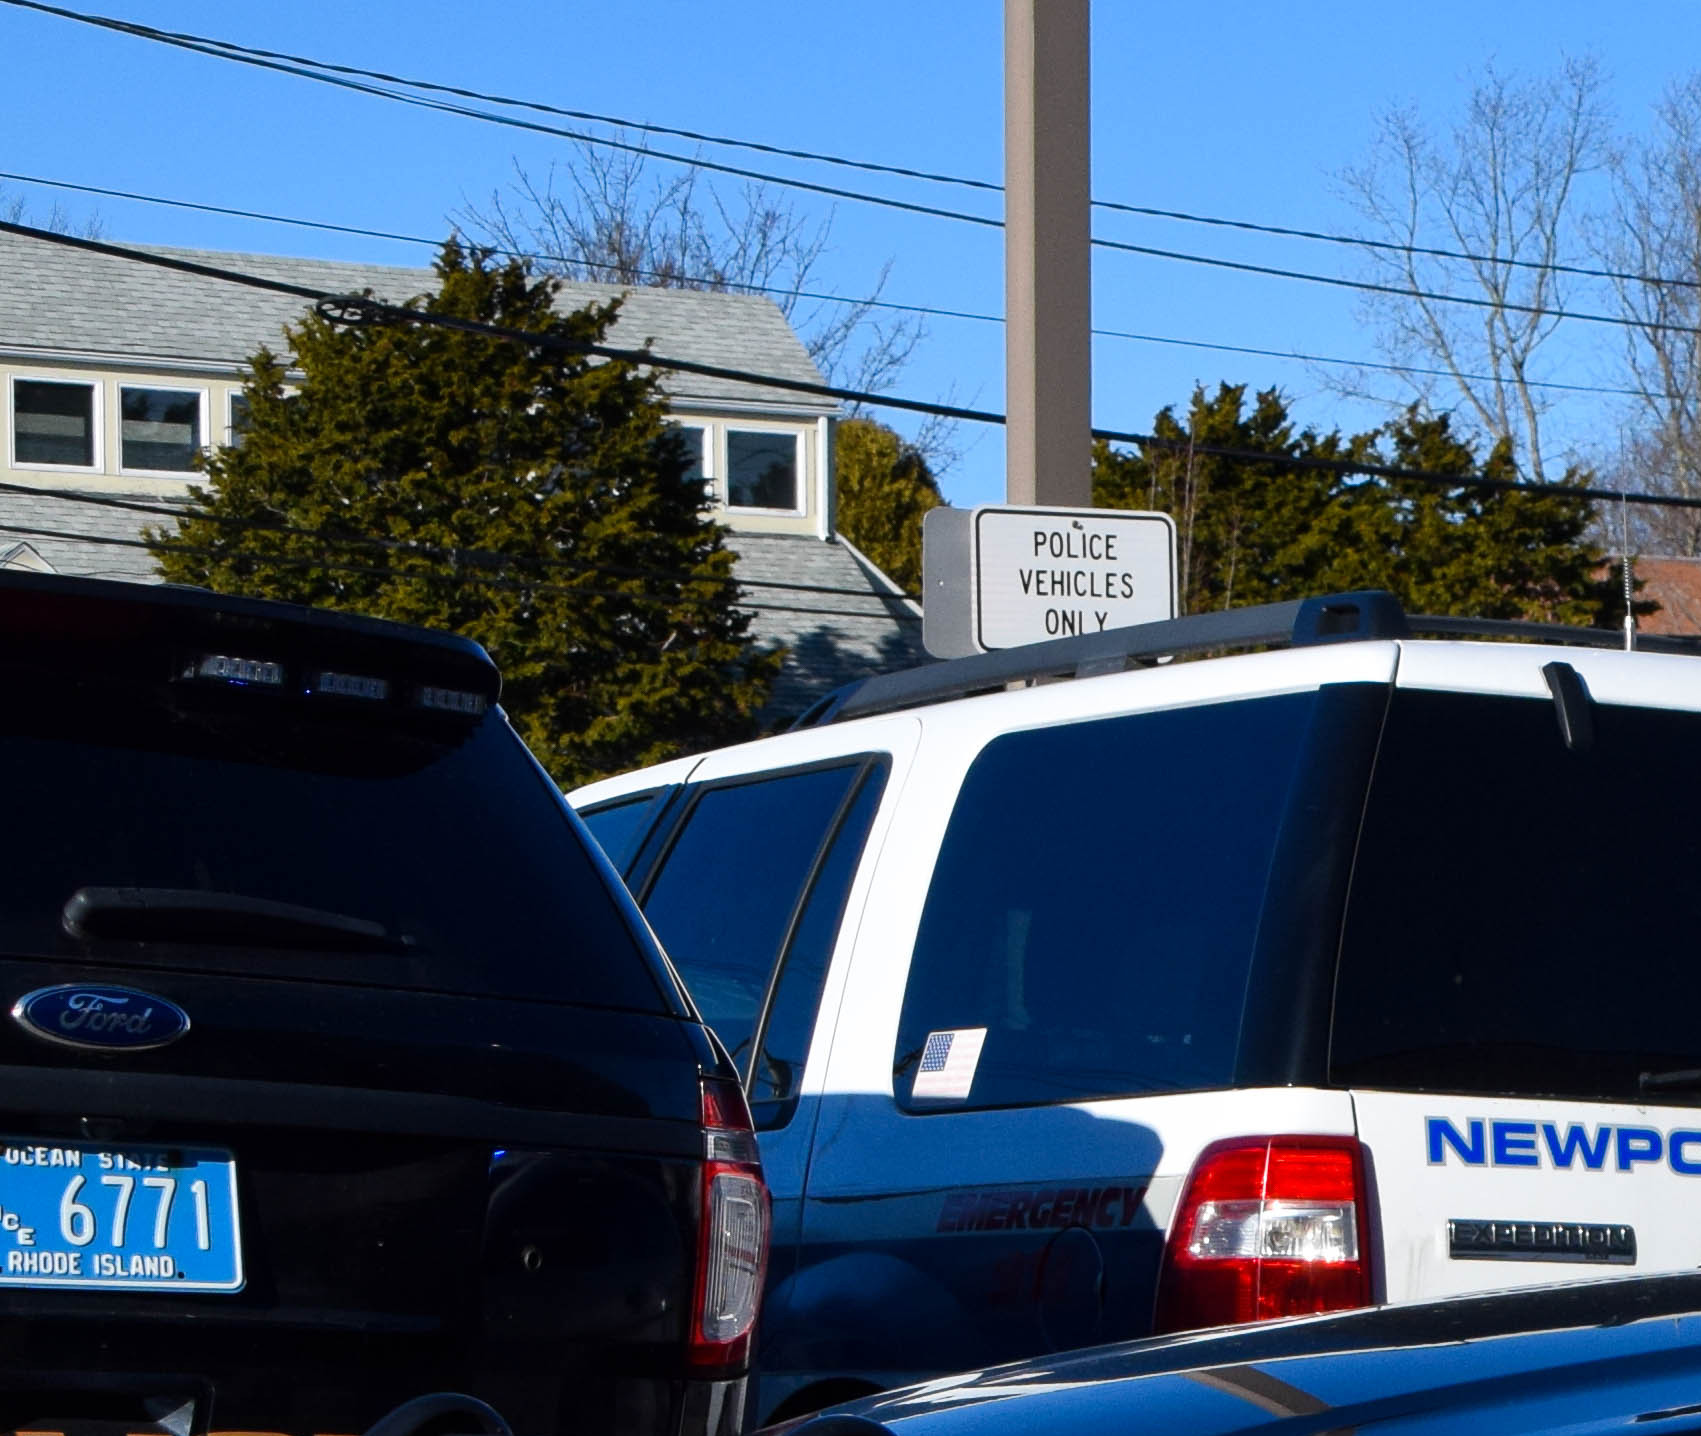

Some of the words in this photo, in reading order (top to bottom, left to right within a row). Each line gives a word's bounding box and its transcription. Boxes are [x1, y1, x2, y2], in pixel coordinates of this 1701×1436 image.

[1034, 531, 1117, 560] POLICE
[1019, 568, 1134, 599] VEHICLES
[60, 993, 152, 1035] Ford
[60, 1174, 210, 1250] 6771
[935, 1186, 1147, 1232] EMERGENCY
[8, 1250, 82, 1274] RHODE
[94, 1253, 175, 1278] ISLAND
